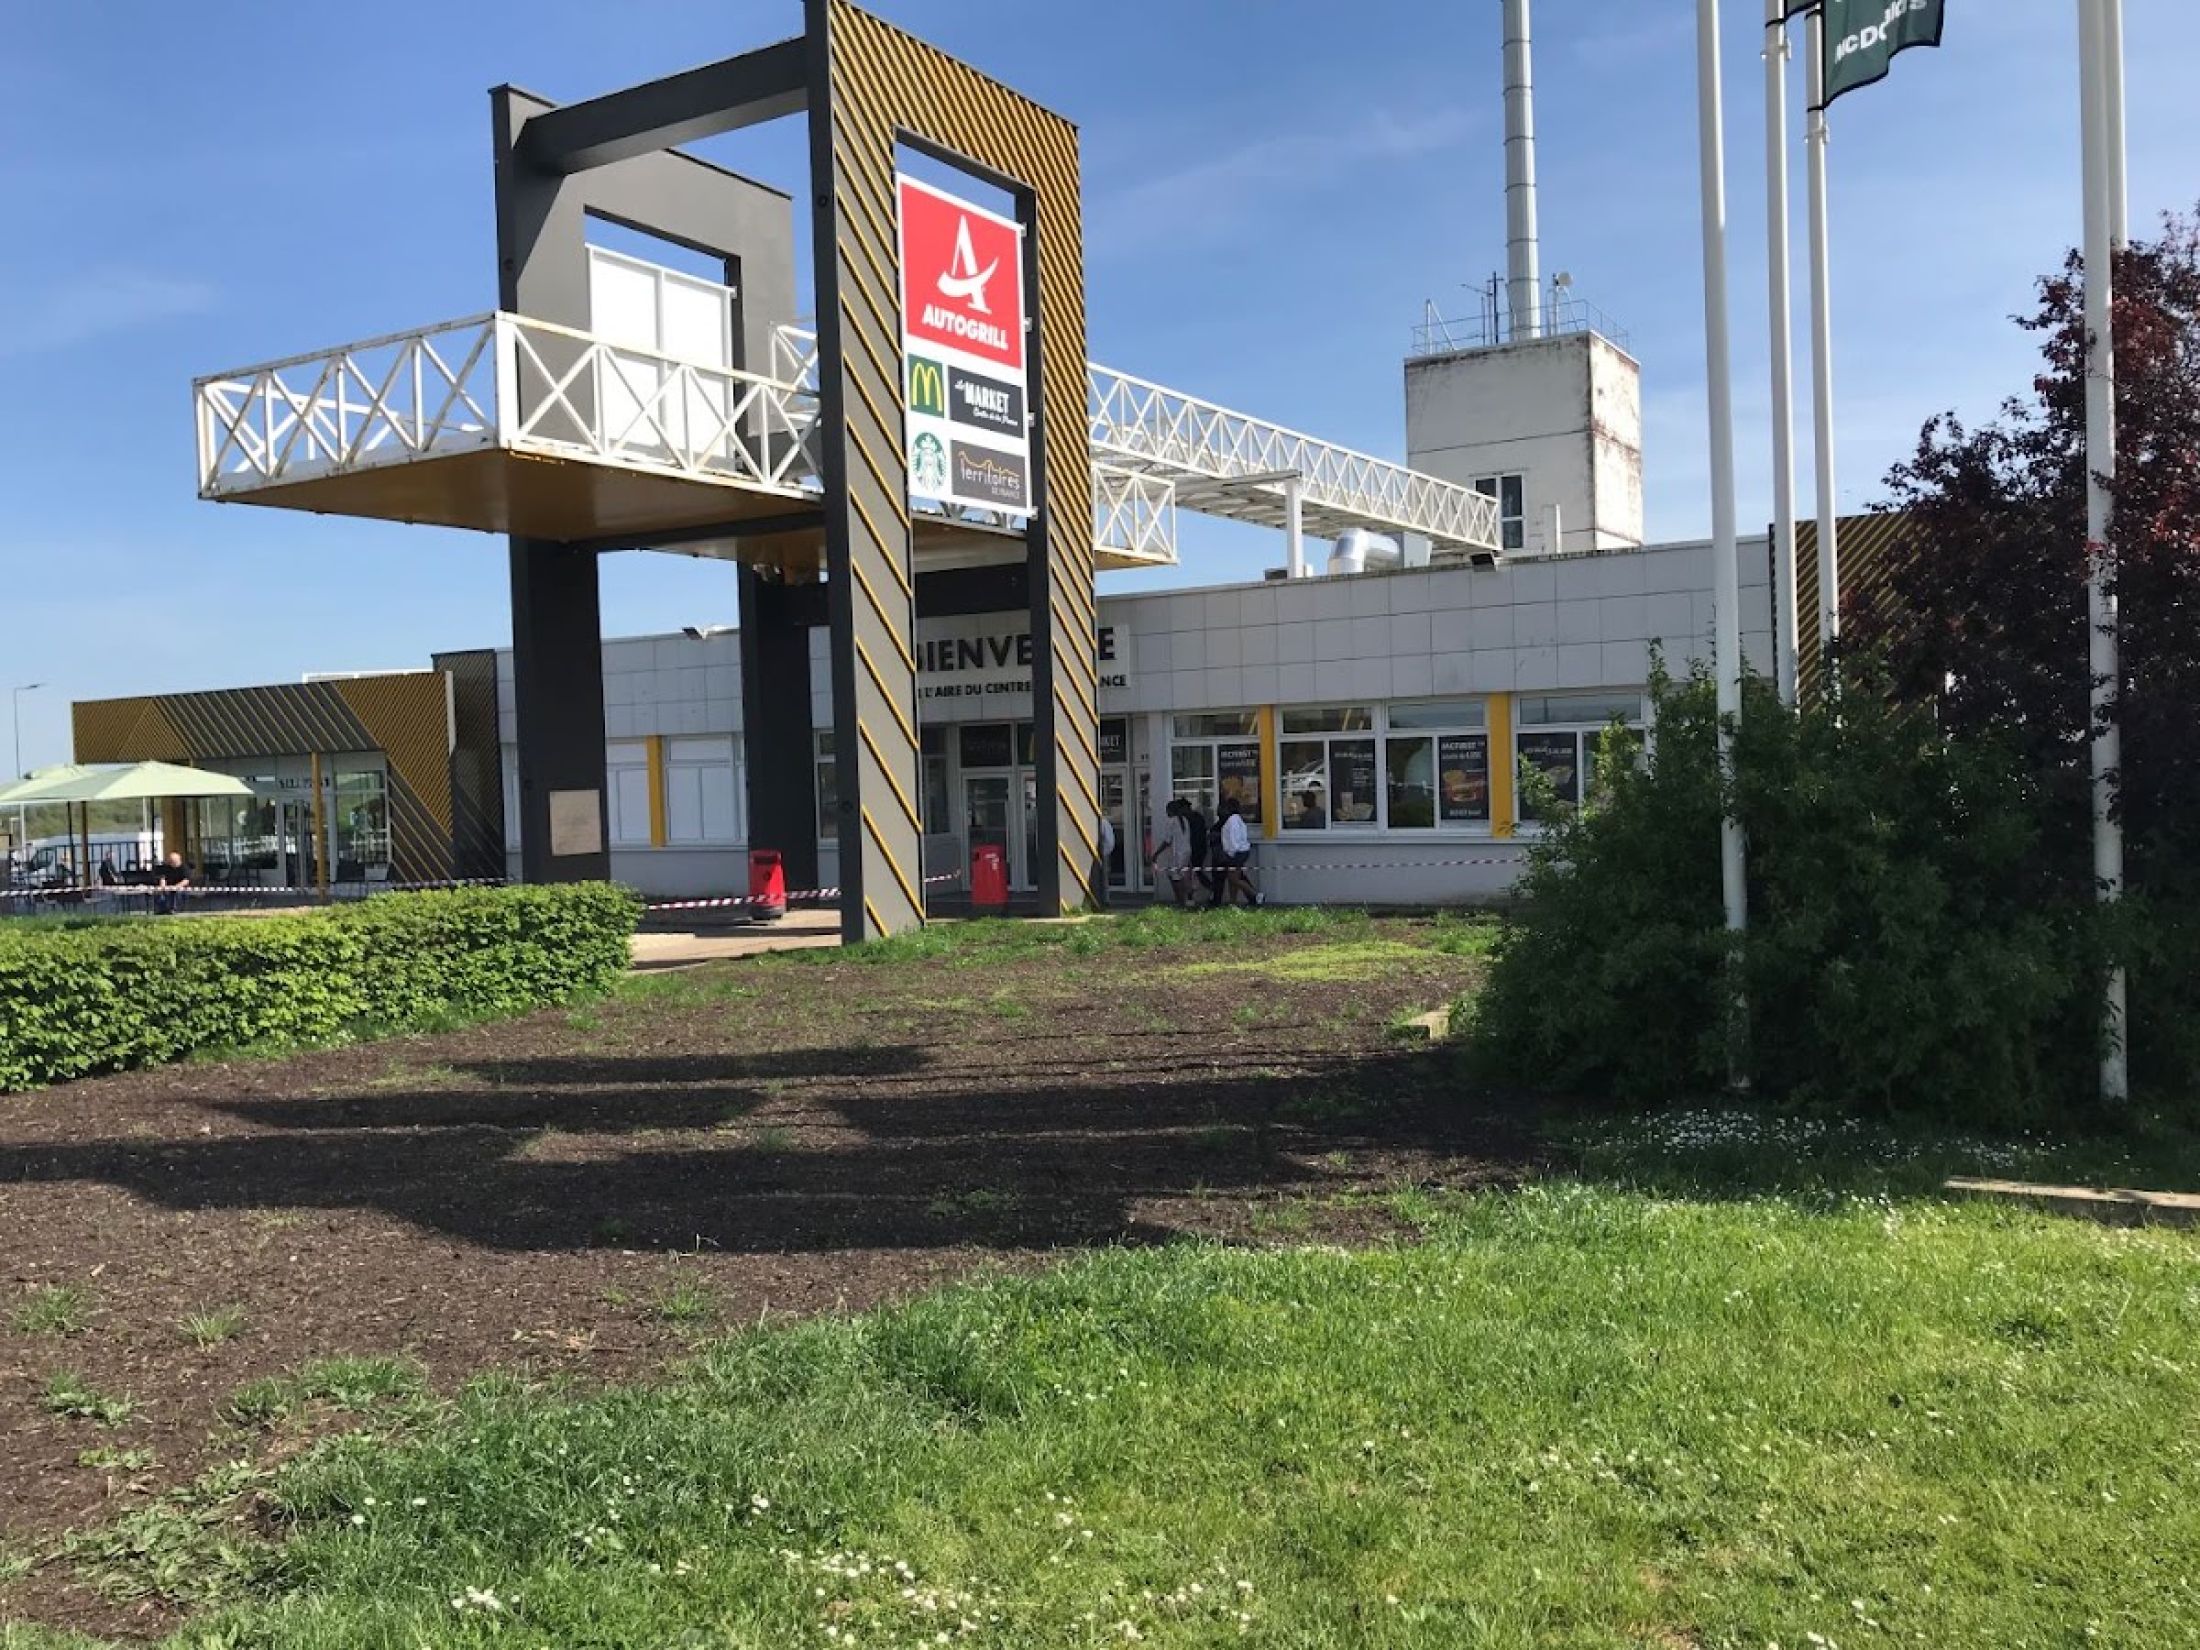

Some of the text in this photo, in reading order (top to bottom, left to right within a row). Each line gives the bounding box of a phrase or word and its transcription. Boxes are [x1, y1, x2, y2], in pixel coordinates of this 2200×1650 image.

[922, 303, 1009, 350] AUTOGRILL
[964, 381, 1009, 413] MARKET
[925, 685, 962, 697] L'AIRE
[965, 684, 981, 695] DU
[985, 682, 1031, 693] CENTRE
